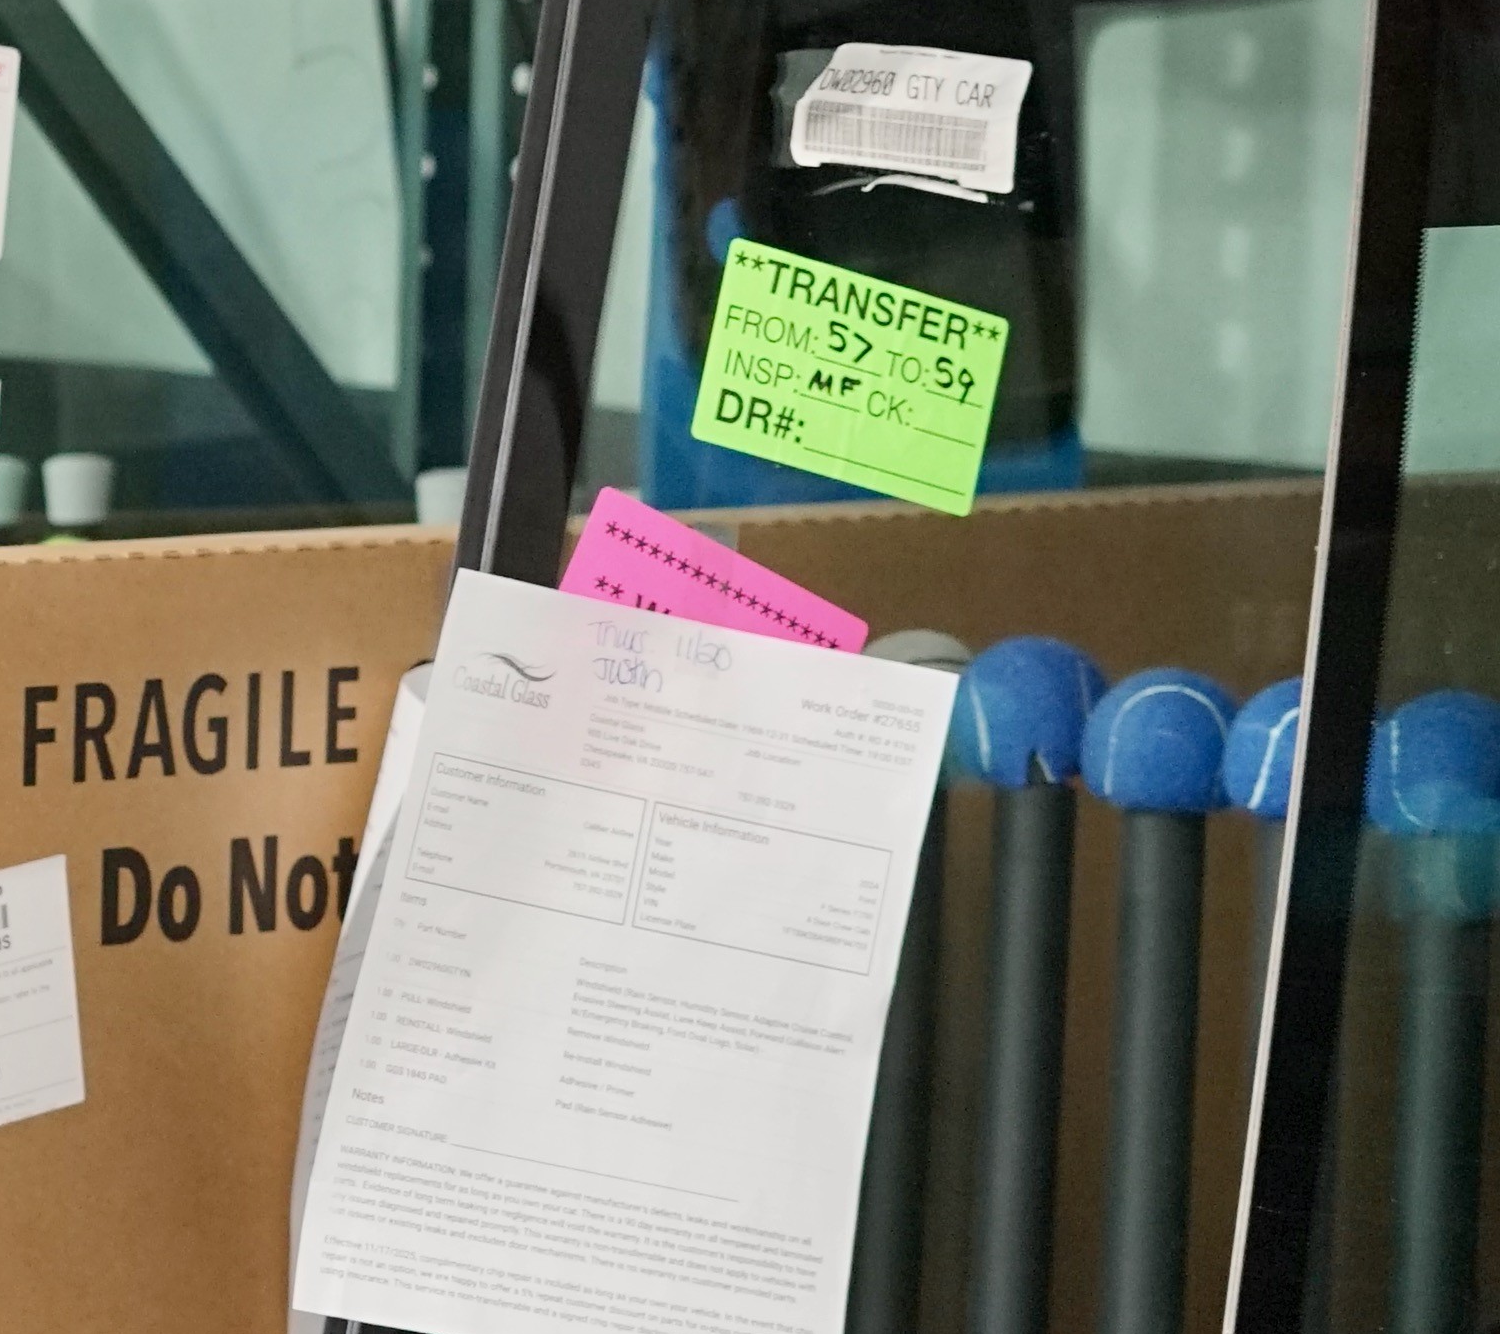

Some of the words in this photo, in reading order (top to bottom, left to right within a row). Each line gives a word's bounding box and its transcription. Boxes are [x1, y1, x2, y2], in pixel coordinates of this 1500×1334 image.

[819, 67, 895, 97] DW02960
[906, 73, 945, 102] GTY
[955, 79, 996, 108] CAR
[723, 304, 820, 355] FROM:
[886, 349, 930, 389] TO:
[723, 349, 802, 394] INSP:
[866, 390, 916, 427] CK:
[714, 388, 806, 444] DR#:
[452, 665, 508, 700] Coastal
[512, 680, 552, 710] Glass
[22, 665, 361, 788] FRAGILE
[799, 697, 832, 715] Work
[833, 704, 870, 723] Order
[434, 762, 485, 784] Customer
[484, 772, 547, 797] Information
[657, 811, 700, 831] Vehicle
[701, 820, 771, 846] Information
[99, 846, 201, 949] Do
[228, 834, 355, 937] Not
[350, 1087, 386, 1106] Notes
[344, 1113, 395, 1133] CUSTOMER
[338, 1144, 390, 1163] WARRANTY
